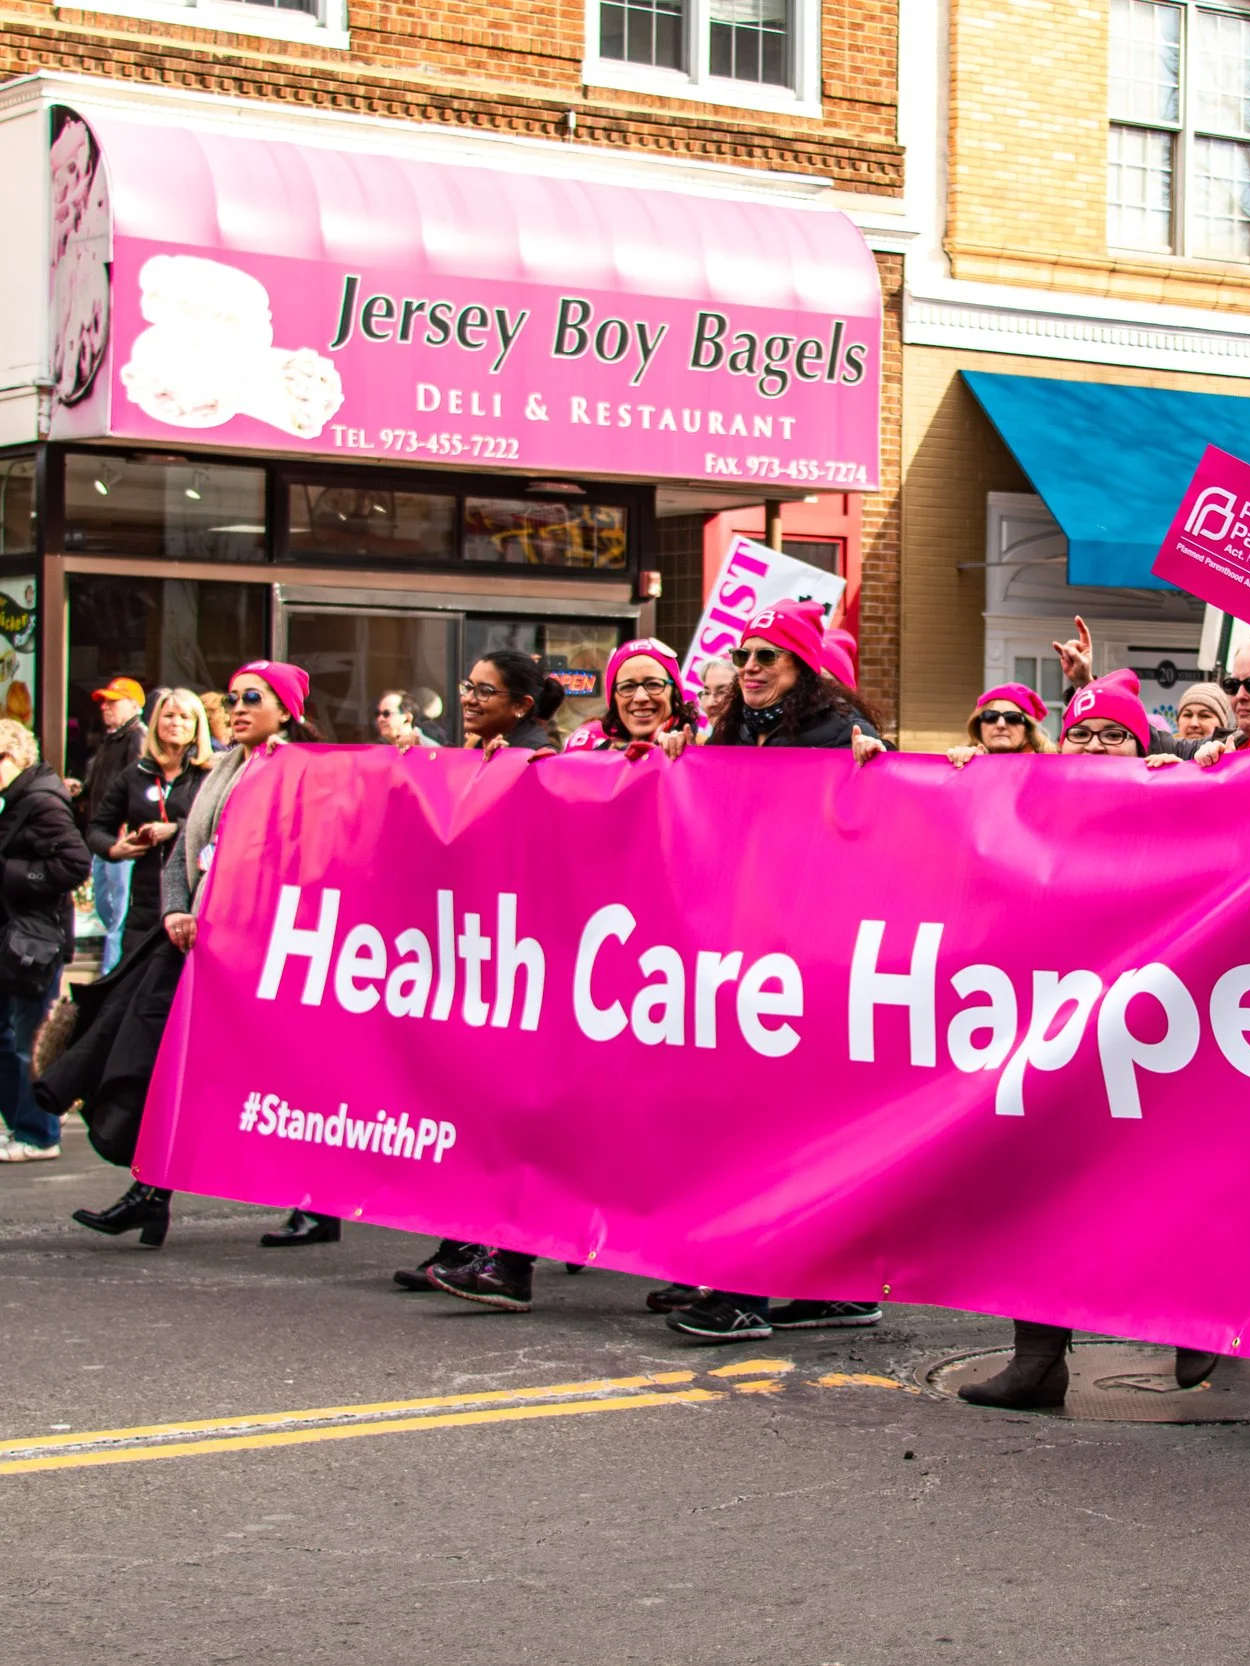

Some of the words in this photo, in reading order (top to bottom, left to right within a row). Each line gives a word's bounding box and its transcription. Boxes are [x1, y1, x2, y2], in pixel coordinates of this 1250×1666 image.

[328, 273, 530, 375] Jersey
[551, 296, 670, 387] Boy
[688, 310, 868, 399] Bagels
[416, 383, 503, 418] DELI
[525, 393, 549, 421] &
[570, 396, 796, 440] RESTAURANT
[380, 428, 520, 460] 973-455-7222
[746, 456, 868, 484] 973-455-7274
[1175, 542, 1205, 564] Planned
[1204, 557, 1246, 584] Parenthood
[1223, 543, 1245, 561] Act.
[1160, 667, 1175, 683] 20
[256, 884, 546, 1032] Health
[572, 903, 804, 1058] Care
[238, 1091, 457, 1164] #StandwithPP
